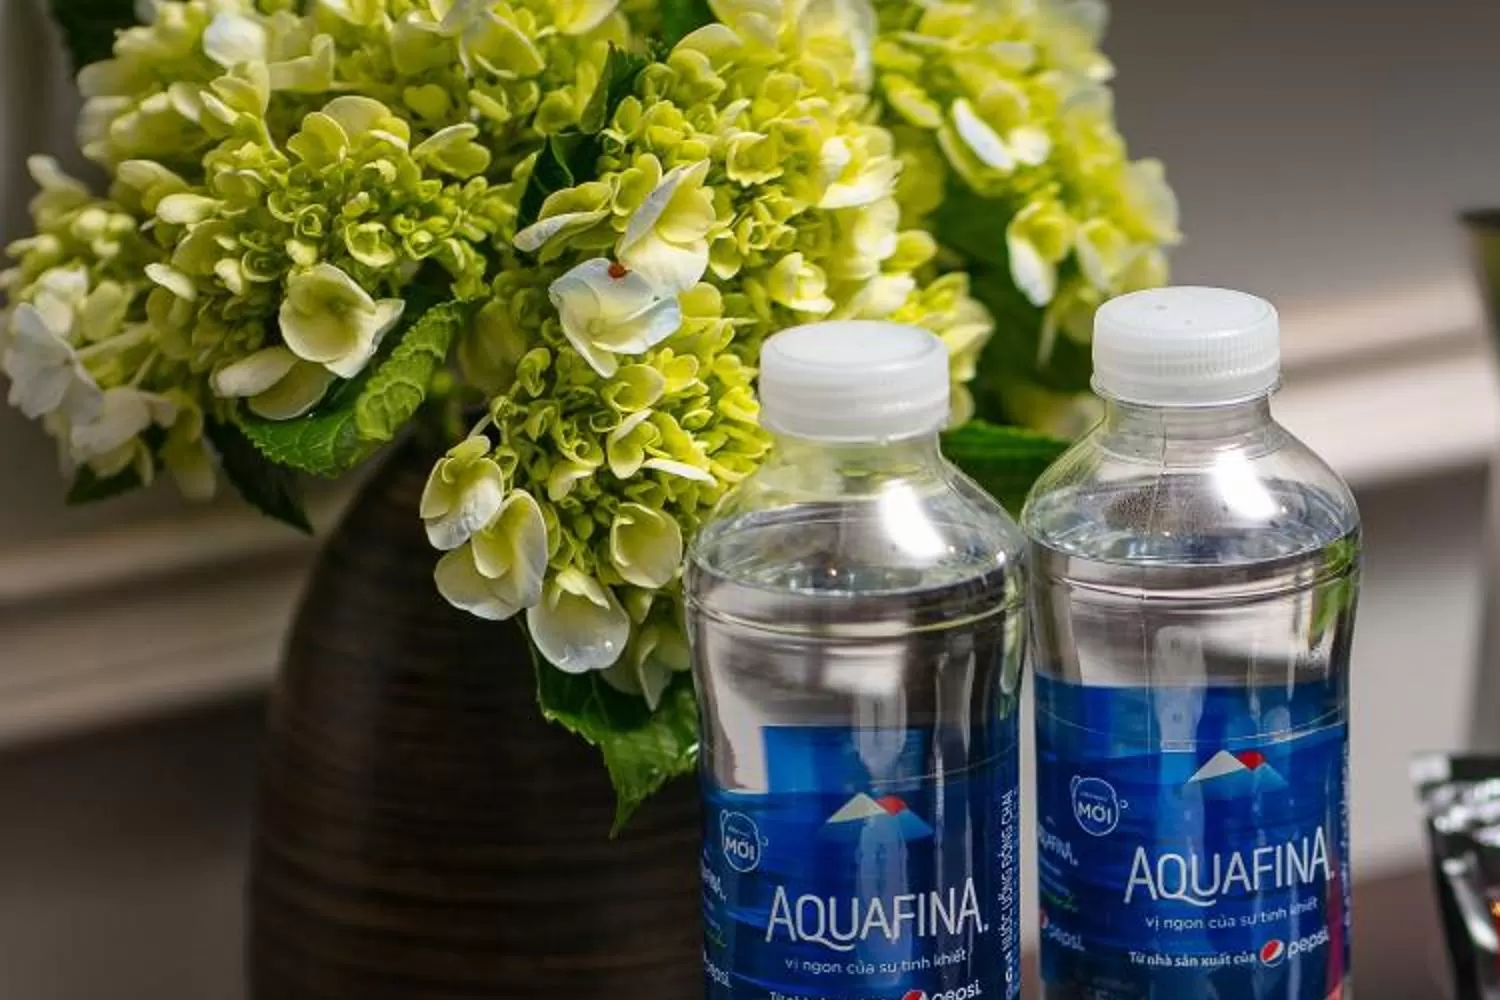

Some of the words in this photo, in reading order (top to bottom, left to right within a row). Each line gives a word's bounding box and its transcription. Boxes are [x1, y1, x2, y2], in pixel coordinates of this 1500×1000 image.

[1124, 826, 1331, 907] AQUAFINA
[765, 877, 982, 951] AQUAFINA
[1163, 918, 1204, 933] ngon
[1287, 925, 1330, 959] pepsi
[802, 960, 842, 975] ngon
